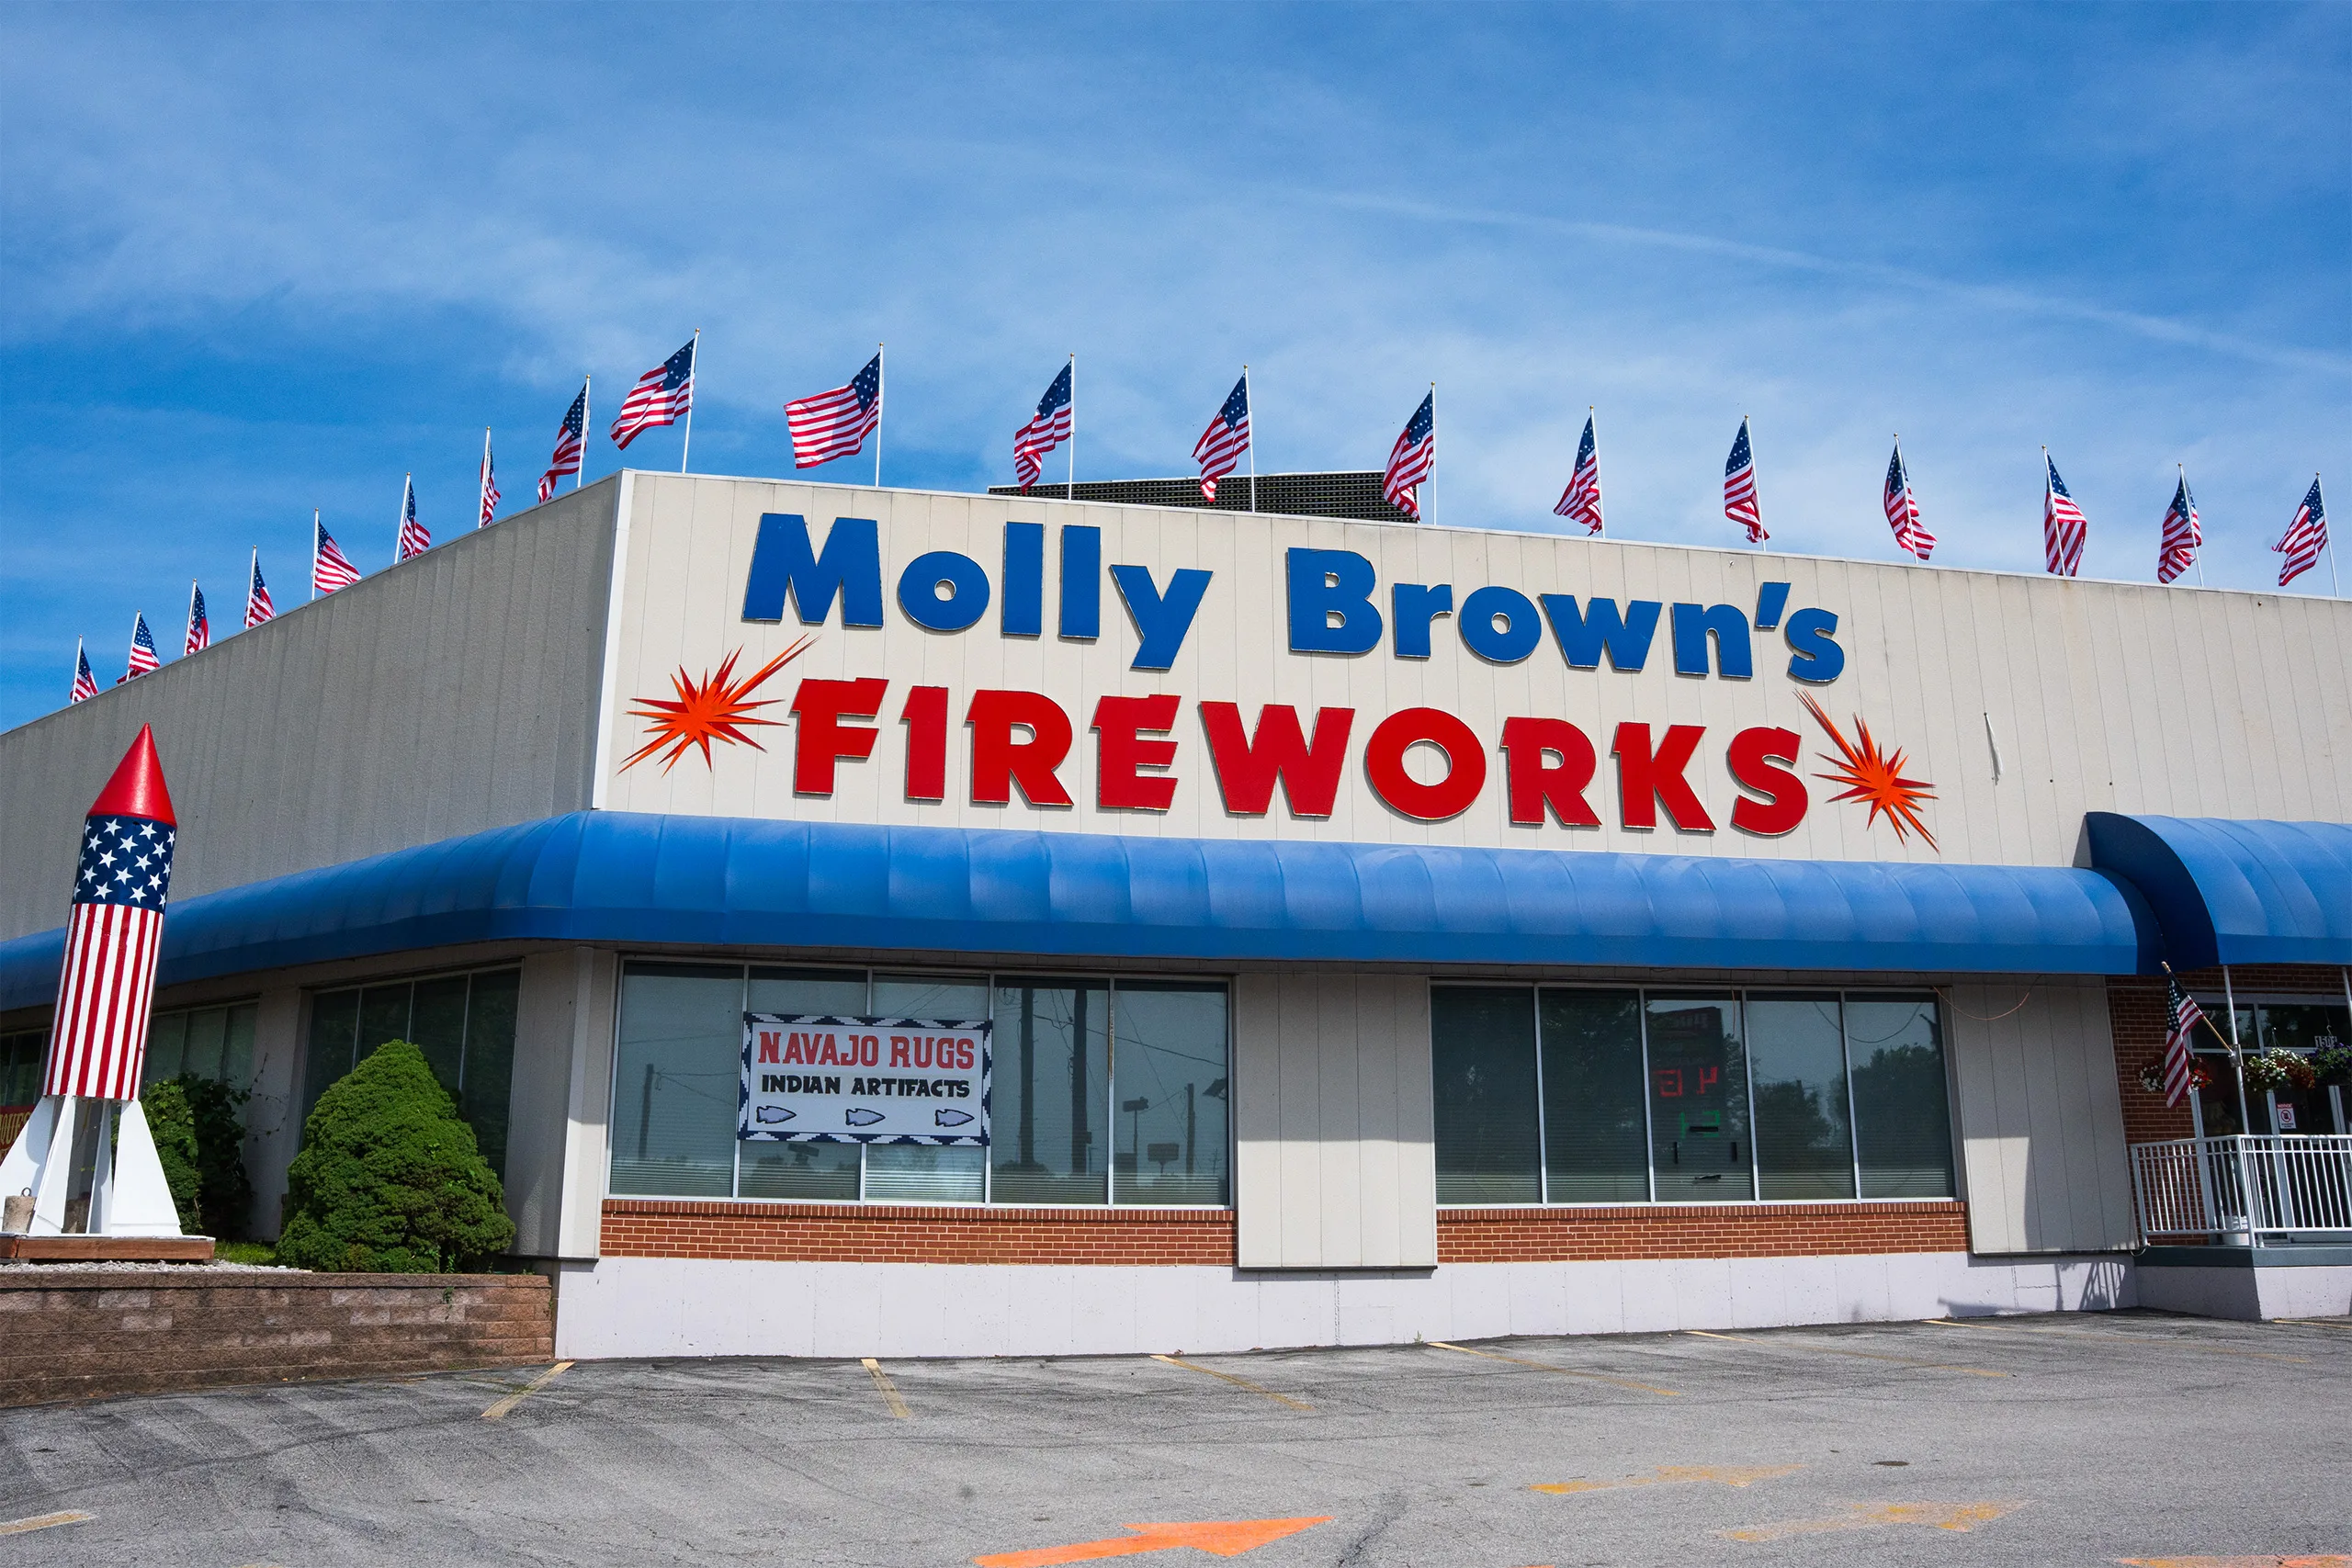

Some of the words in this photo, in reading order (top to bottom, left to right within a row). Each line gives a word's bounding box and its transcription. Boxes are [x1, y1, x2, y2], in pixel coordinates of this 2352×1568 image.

[742, 513, 1213, 670] Molly
[1287, 547, 1845, 682] Brown's
[791, 677, 1808, 836] FIREWORKS
[758, 1032, 879, 1066] NAVAJO
[889, 1035, 975, 1069] RUGS
[762, 1075, 841, 1094] INDIAN
[851, 1077, 970, 1099] ARTIFACTS
